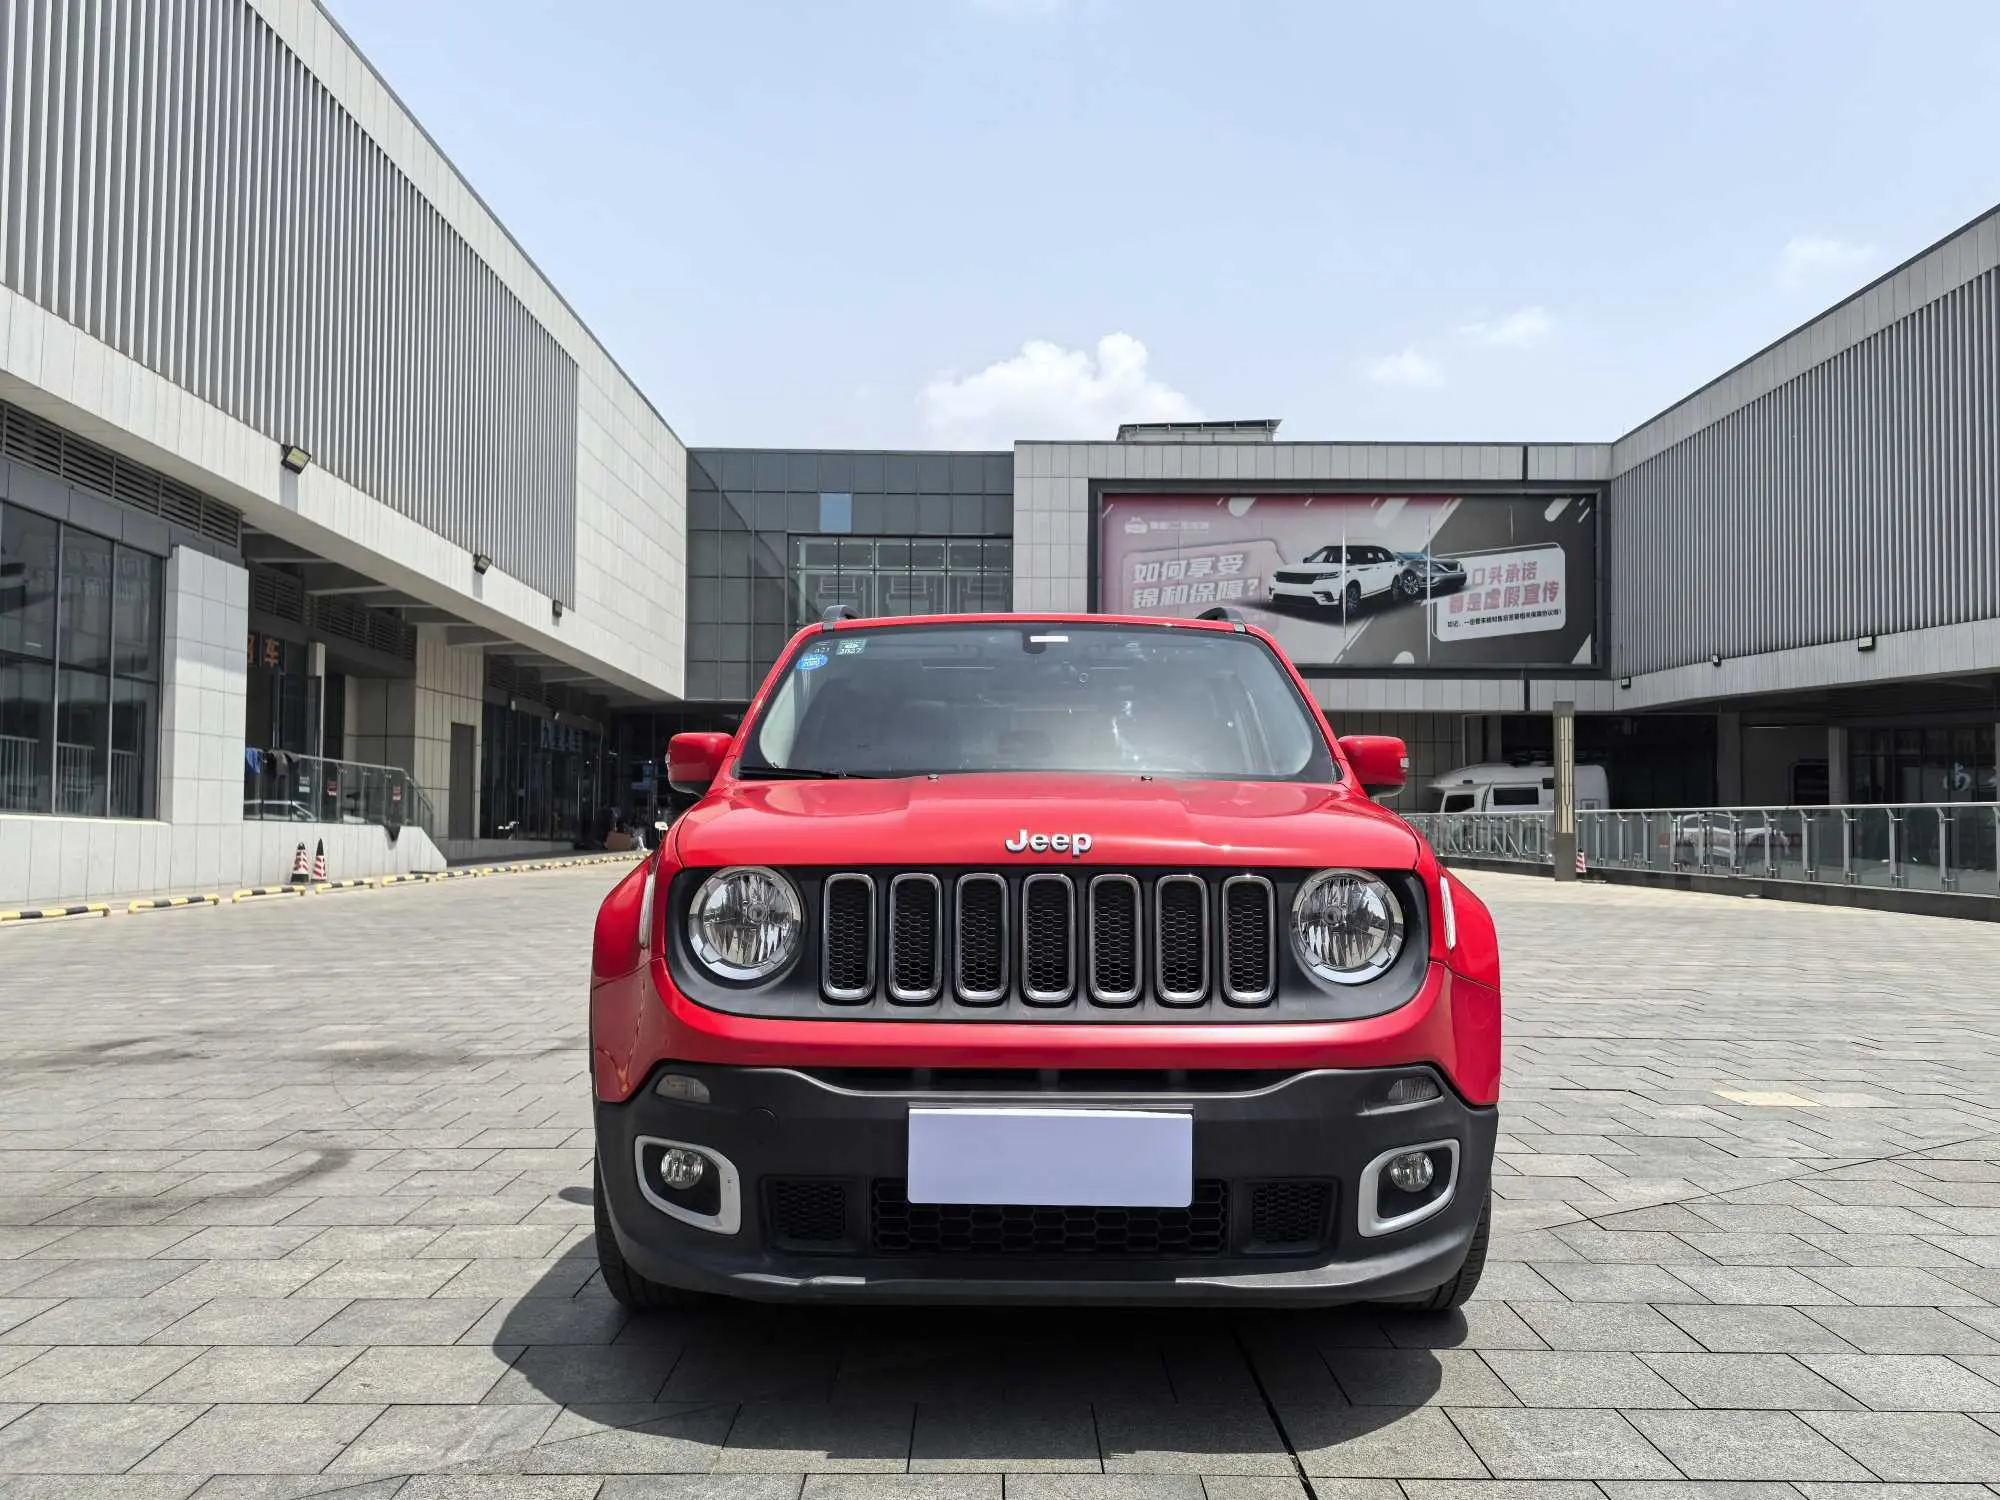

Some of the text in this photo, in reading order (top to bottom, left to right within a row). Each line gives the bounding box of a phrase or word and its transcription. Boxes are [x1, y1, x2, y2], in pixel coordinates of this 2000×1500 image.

[1133, 554, 1244, 584] 如何享受
[1472, 561, 1538, 586] 口头承诺
[1449, 581, 1560, 615] 都是虚假宣传
[1005, 829, 1092, 857] Jeep
